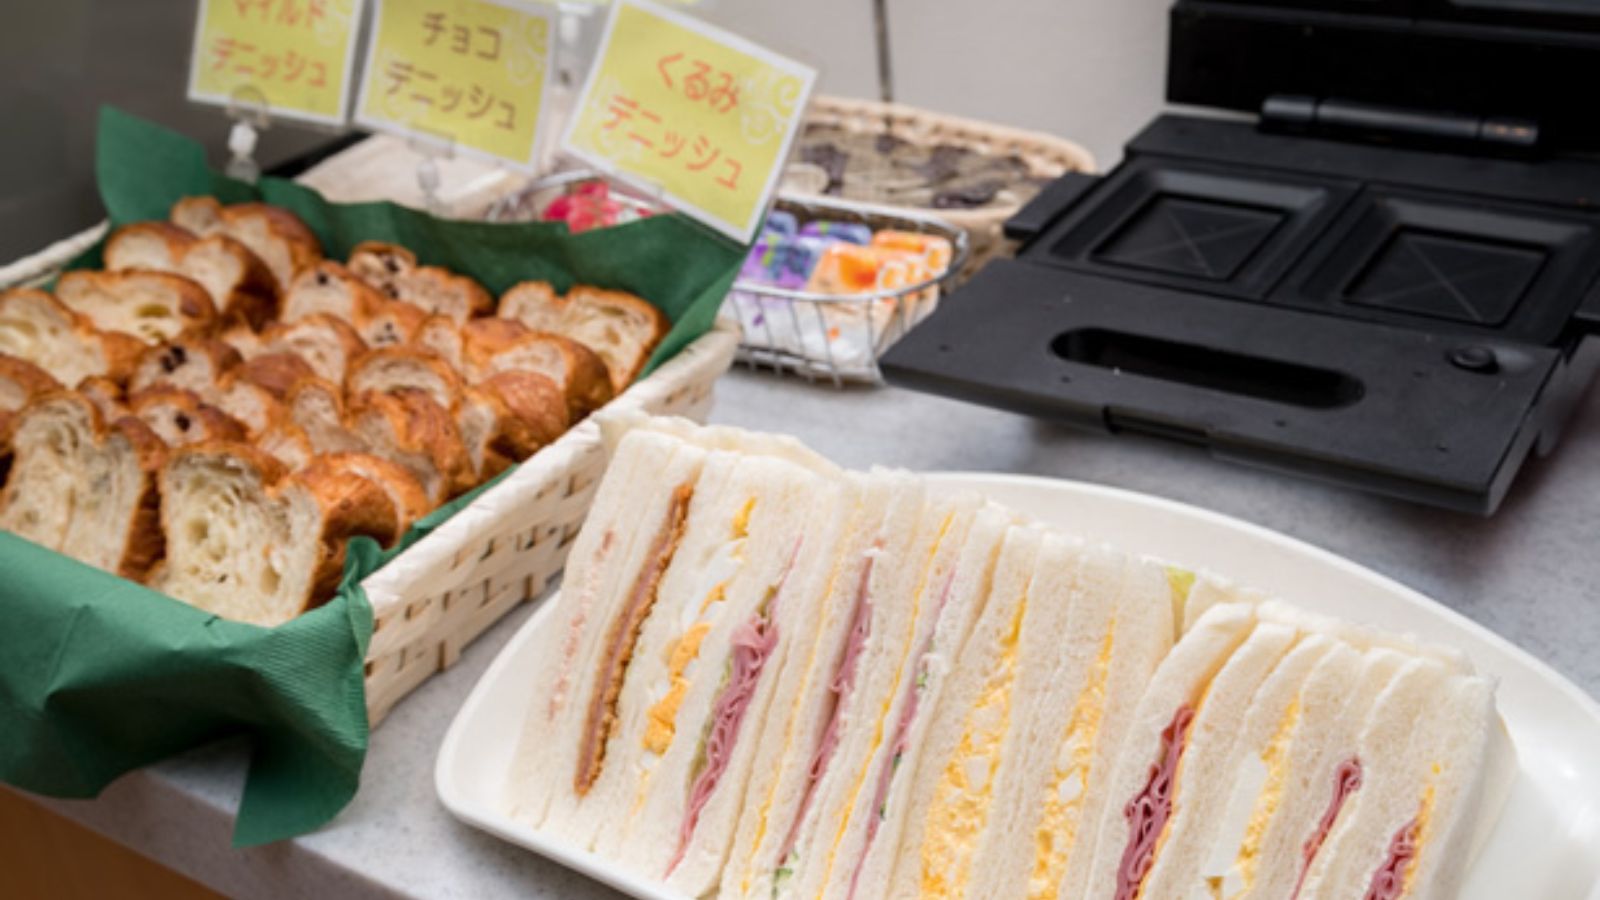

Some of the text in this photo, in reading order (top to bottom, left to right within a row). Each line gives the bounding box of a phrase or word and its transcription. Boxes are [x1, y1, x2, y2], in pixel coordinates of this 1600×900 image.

[211, 36, 327, 88] デニッシュ
[422, 12, 500, 61] チョコ
[386, 61, 516, 131] デニッシュ
[657, 52, 741, 114] くるみ
[602, 95, 742, 190] デニッシュ
